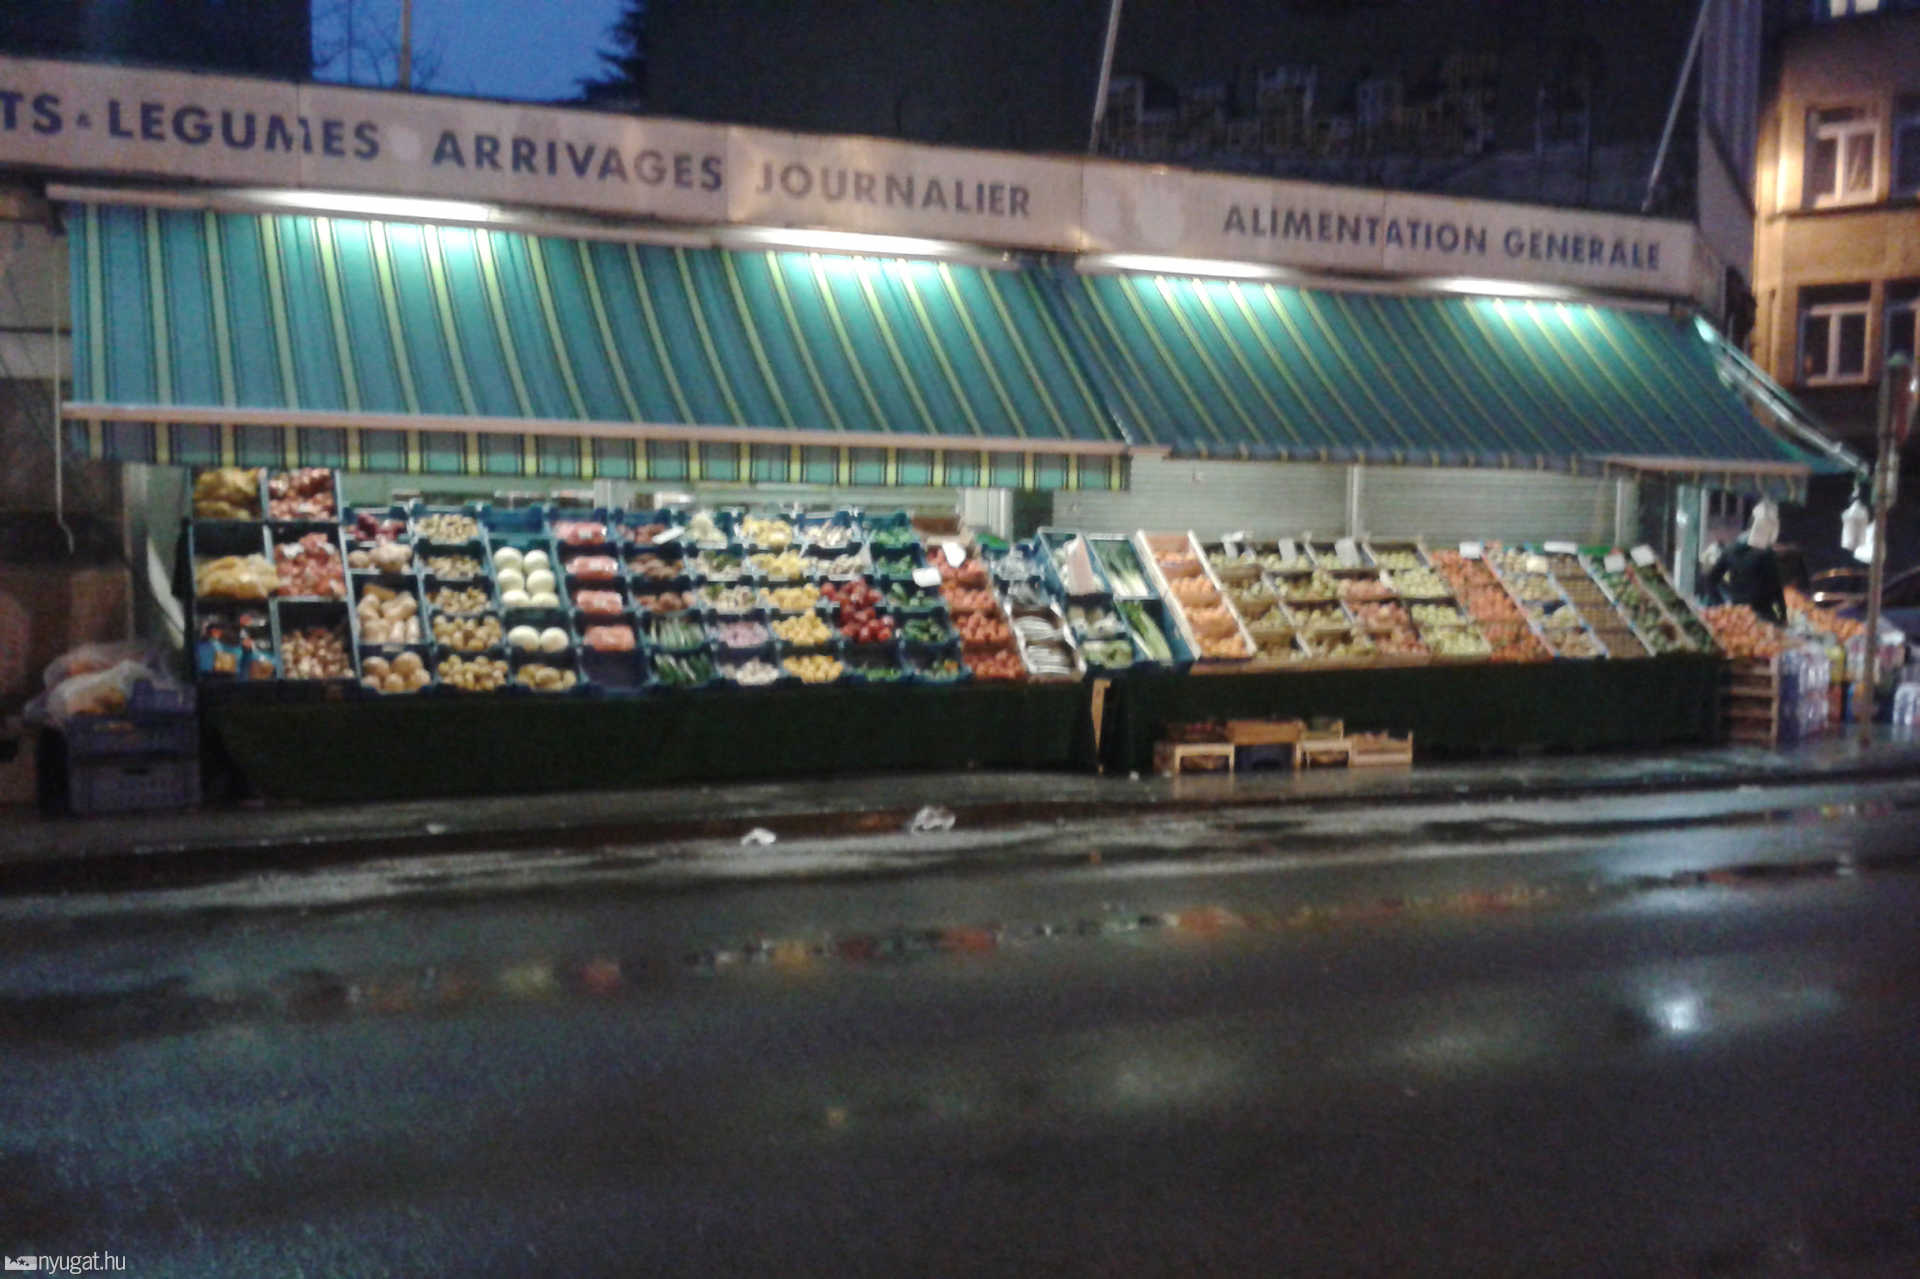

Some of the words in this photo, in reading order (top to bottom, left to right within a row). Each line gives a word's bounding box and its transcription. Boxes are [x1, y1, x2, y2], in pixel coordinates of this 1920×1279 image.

[108, 98, 381, 159] LEGUMES
[432, 130, 724, 190] ARRIVAGES
[757, 163, 1029, 217] JOURNALIER
[1223, 204, 1486, 254] ALIMENTATION
[1504, 227, 1660, 270] GENERALE
